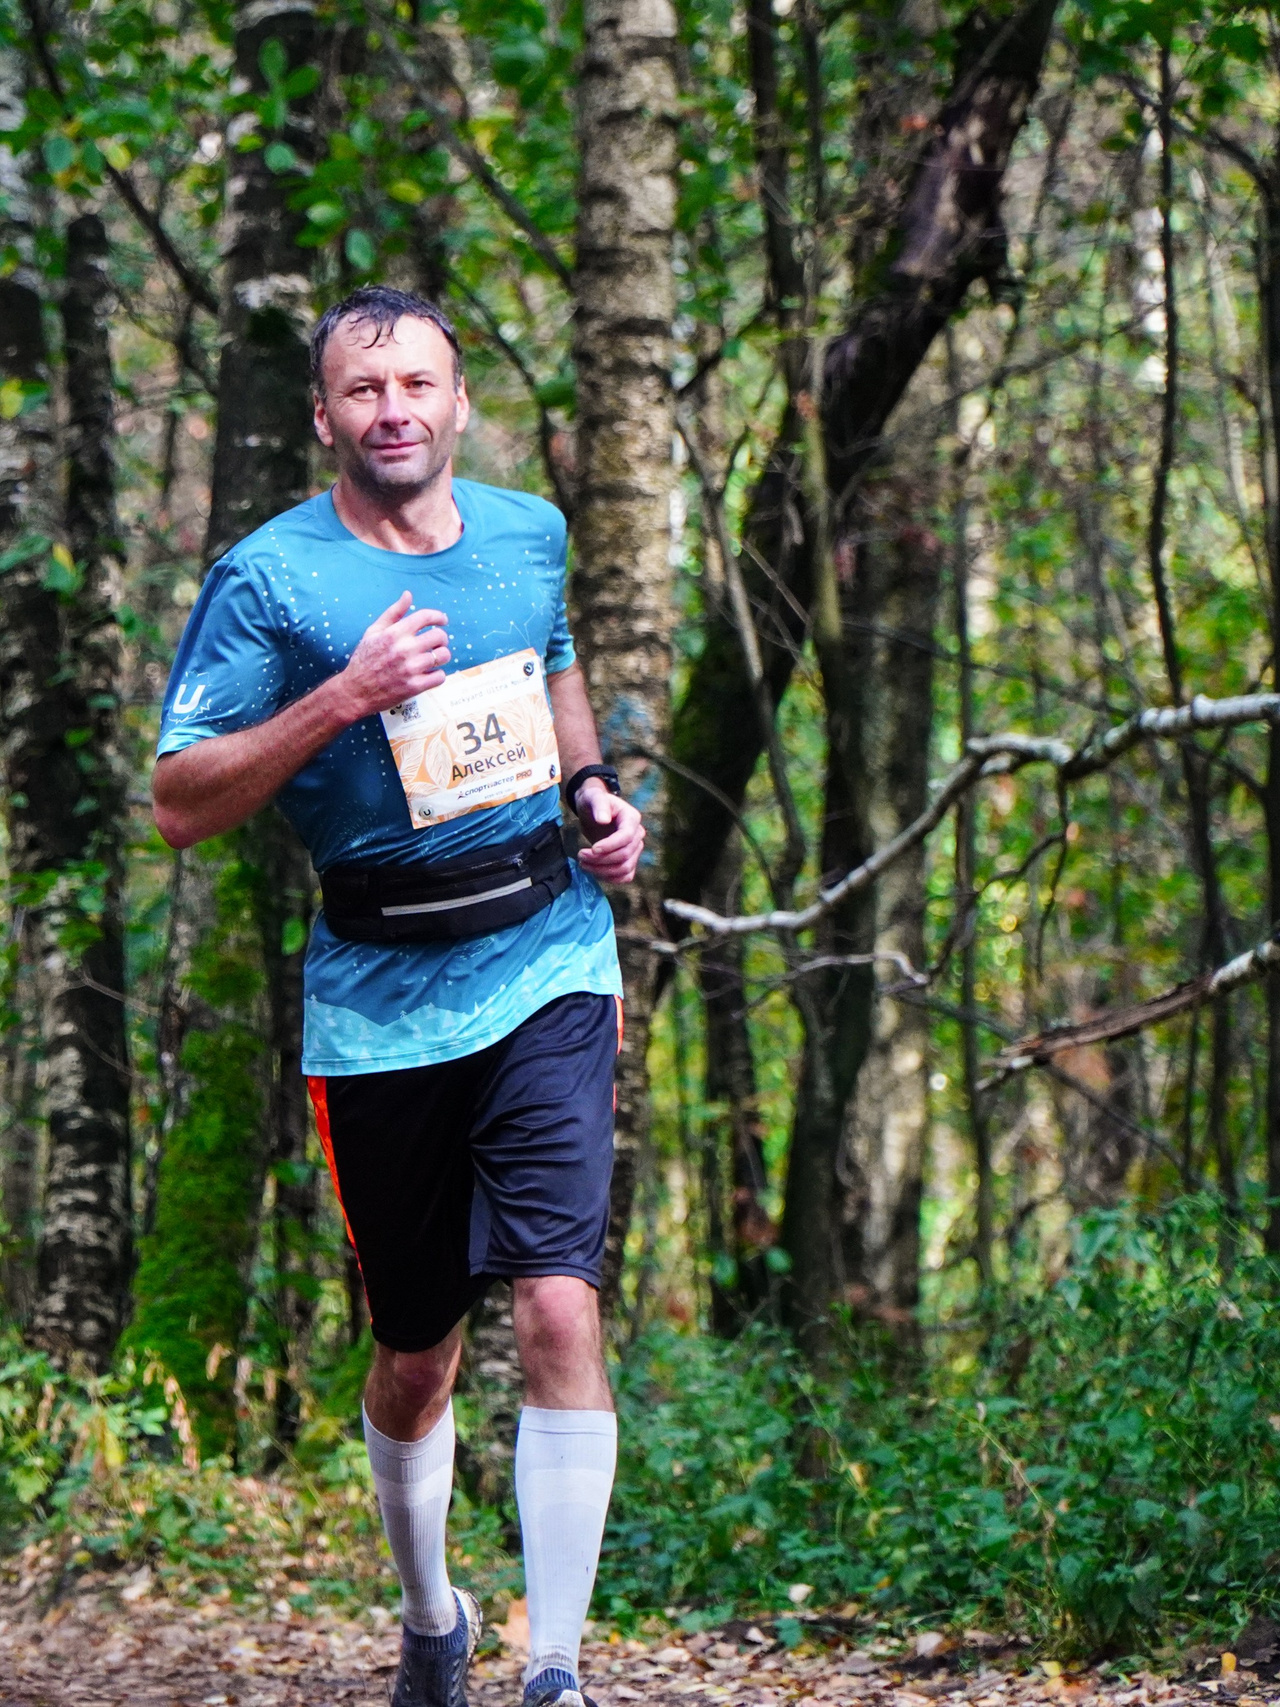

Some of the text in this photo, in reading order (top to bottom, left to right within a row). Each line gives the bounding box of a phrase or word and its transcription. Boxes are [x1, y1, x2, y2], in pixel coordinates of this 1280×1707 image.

[173, 684, 206, 714] U
[456, 713, 507, 756] 34
[452, 742, 527, 781] Алексей
[516, 769, 533, 781] PRO
